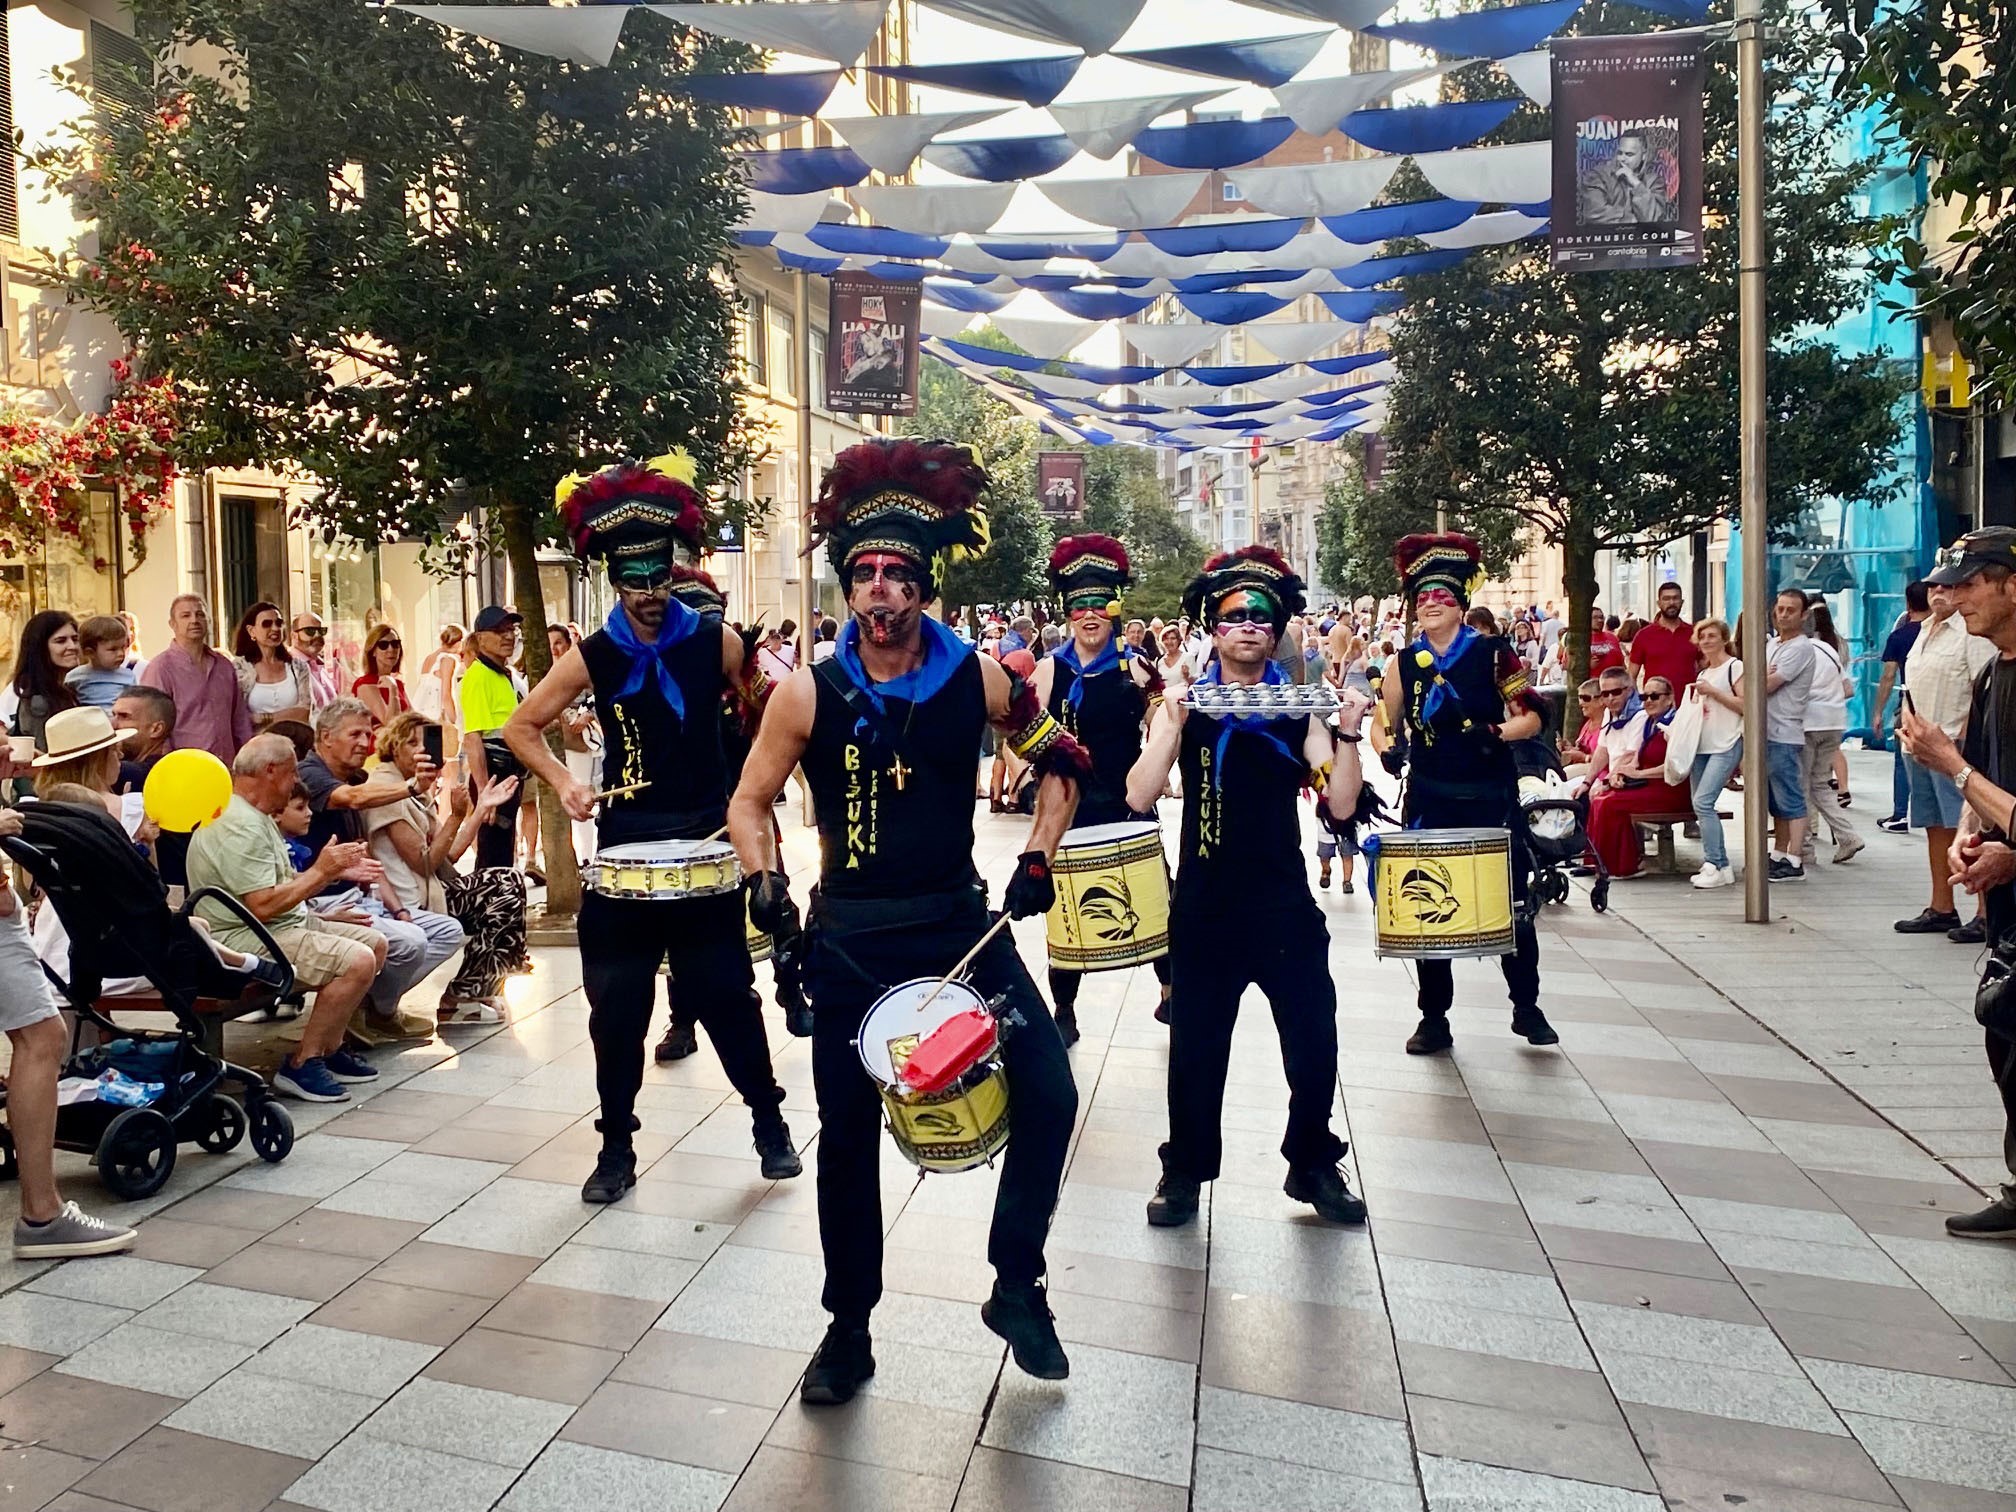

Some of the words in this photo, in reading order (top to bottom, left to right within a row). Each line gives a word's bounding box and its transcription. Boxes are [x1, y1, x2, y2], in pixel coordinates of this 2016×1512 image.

[1592, 58, 1622, 66] JULIO
[1635, 55, 1695, 63] SANTANDER
[1576, 120, 1618, 140] JUAN
[1620, 115, 1679, 135] MAGÁN
[1557, 232, 1669, 244] HOKYMUSIC.COM
[1607, 246, 1648, 256] cantabria
[845, 744, 865, 870] BIZUKA
[1199, 746, 1212, 859] BIZUKA
[1057, 879, 1074, 945] BIZUKA
